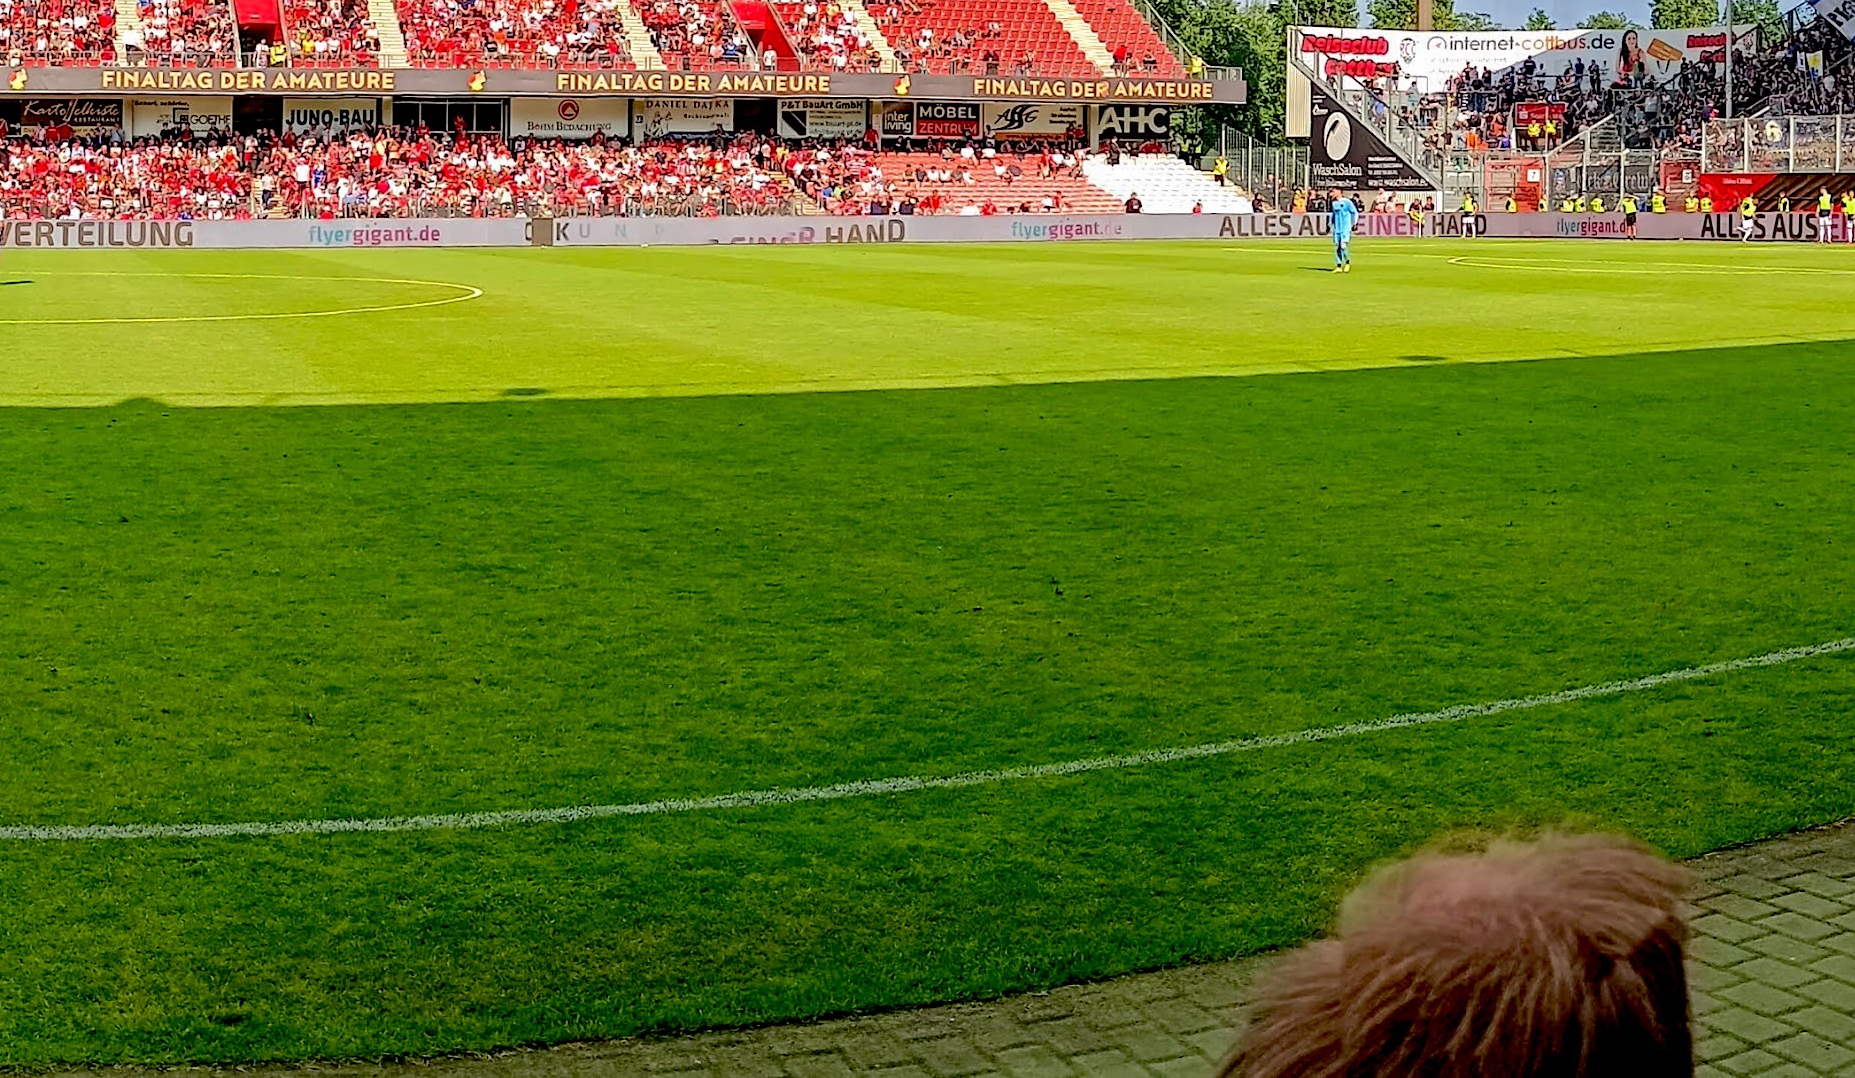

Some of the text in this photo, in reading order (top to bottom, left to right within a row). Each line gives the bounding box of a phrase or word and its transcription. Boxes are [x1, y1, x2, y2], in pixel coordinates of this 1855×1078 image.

[1447, 34, 1615, 52] internet-cottbus.de
[102, 70, 394, 89] FINALTAG DER AMATEURE
[557, 73, 830, 92] FINALTAG DER AMATEURE
[974, 79, 1213, 99] FINALTAG DER AMATEURE
[646, 100, 730, 110] DANIEL DAJKA
[781, 100, 863, 110] P&T BauArt GmbH
[920, 102, 976, 119] MÖBEL
[285, 109, 375, 126] JUNO-BAU
[1098, 108, 1168, 134] AHC
[919, 123, 977, 135] ZENTRUM
[1312, 162, 1363, 177] WaschSalon
[308, 223, 441, 247] flyergigant.de
[826, 219, 905, 243] HAND
[1011, 220, 1123, 241] flyergigant.de
[1220, 215, 1291, 237] ALLES
[1772, 213, 1819, 239] AUS
